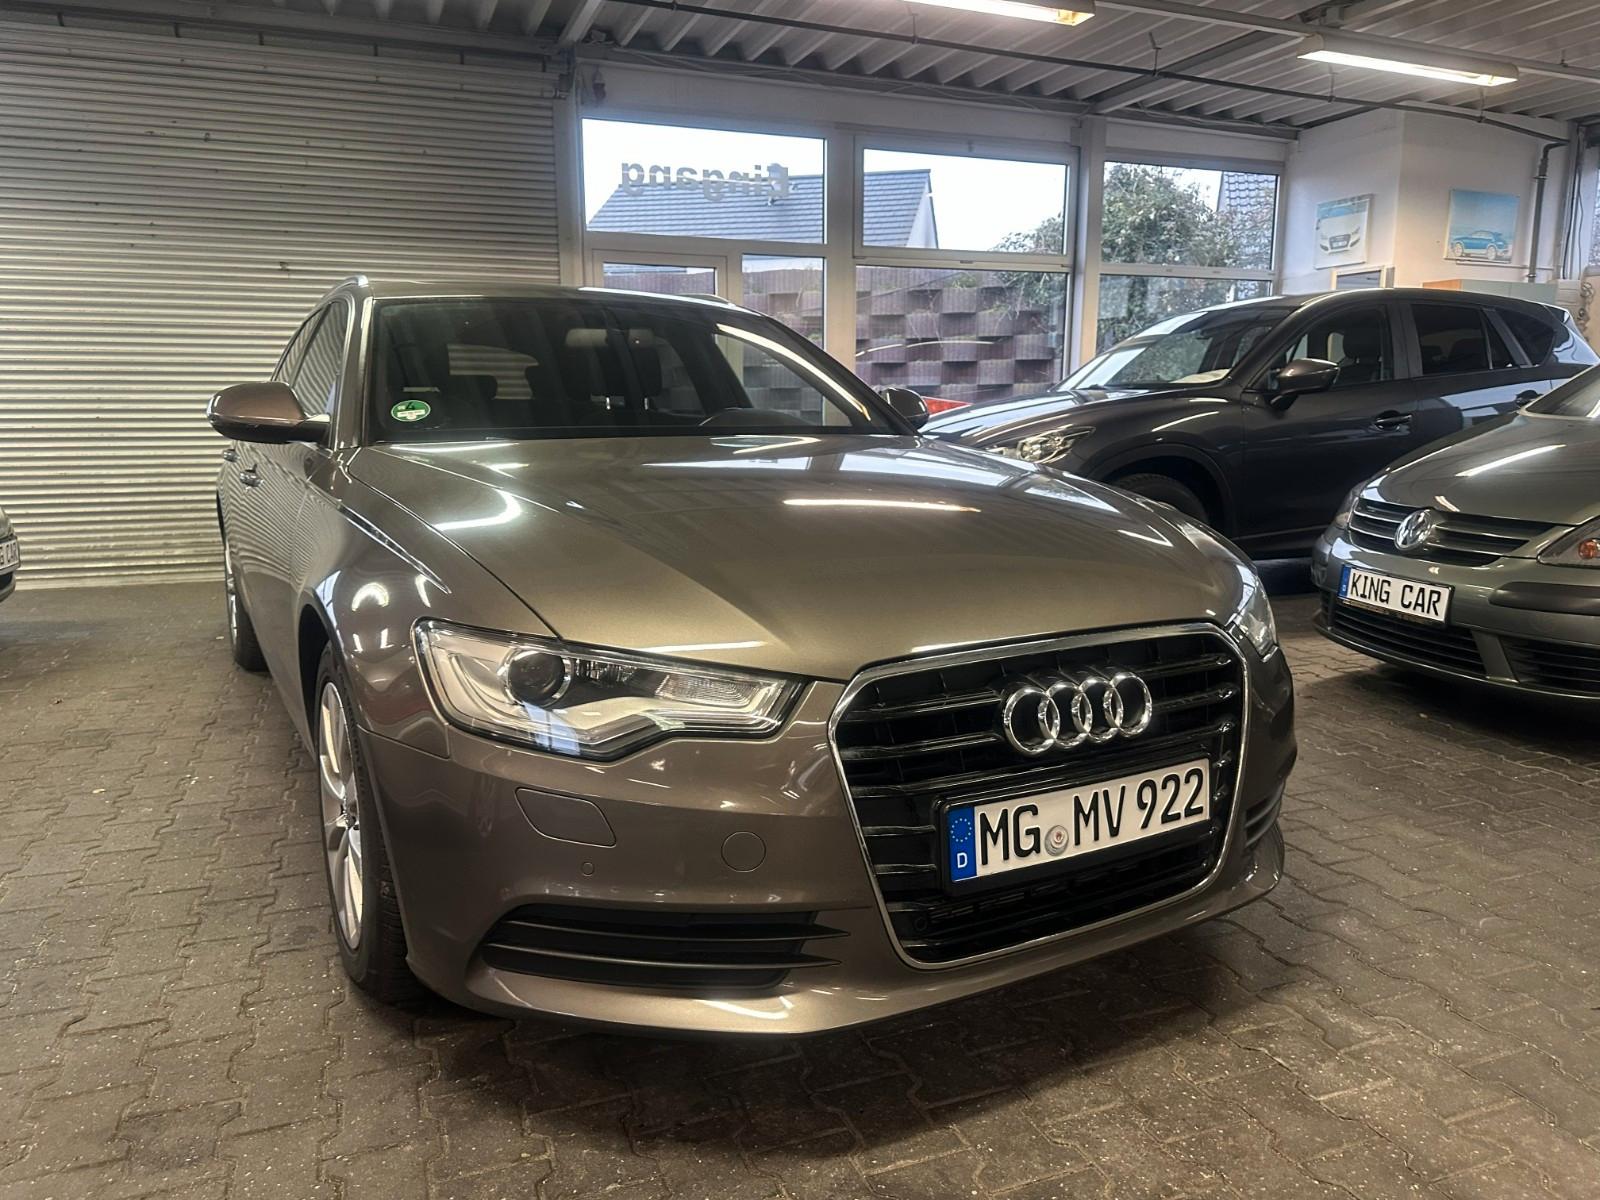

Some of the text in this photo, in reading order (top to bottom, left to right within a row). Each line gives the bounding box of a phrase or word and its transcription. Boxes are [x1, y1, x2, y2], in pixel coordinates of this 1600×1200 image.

[1351, 573, 1391, 604] KING
[1401, 584, 1441, 616] CAR
[980, 767, 1204, 866] MG MV 922
[957, 852, 968, 869] D
